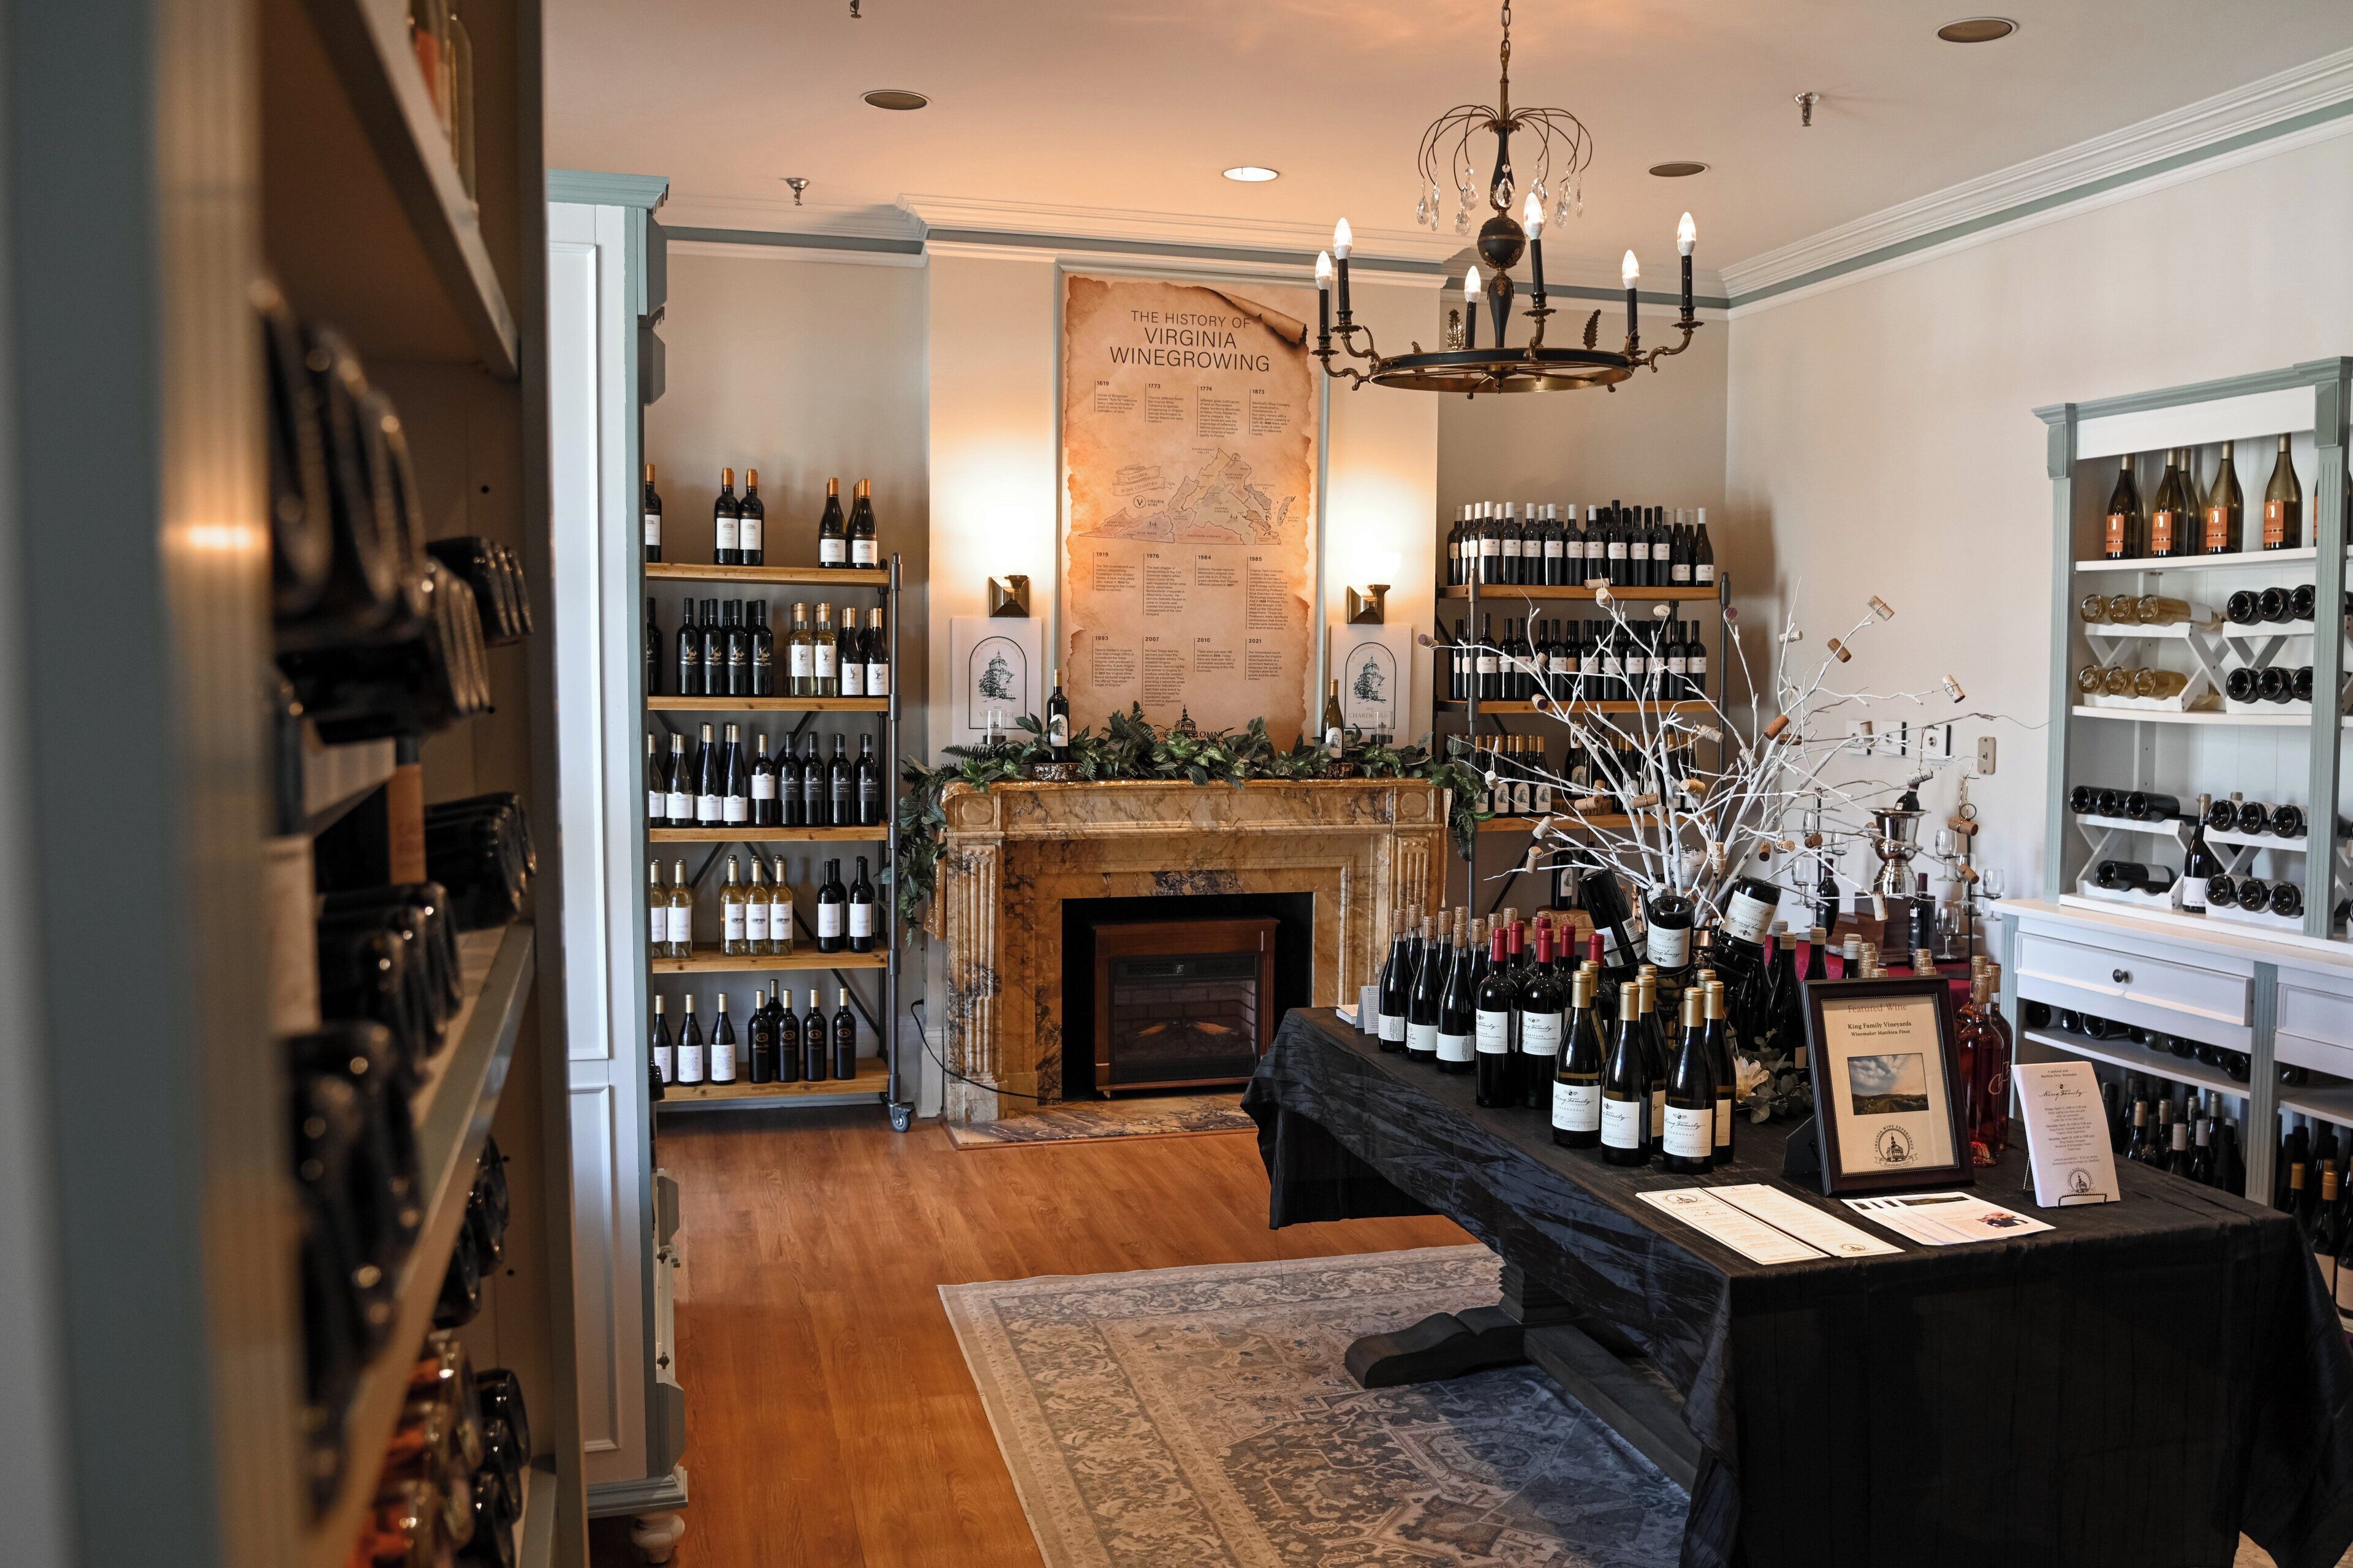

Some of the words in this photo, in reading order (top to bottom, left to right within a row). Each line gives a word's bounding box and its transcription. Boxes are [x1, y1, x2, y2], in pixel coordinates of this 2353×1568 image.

[1131, 310, 1159, 323] THE
[1166, 313, 1225, 327] HISTORY
[1232, 317, 1250, 329] OF
[1145, 327, 1236, 349] VIRGINIA
[1110, 347, 1269, 372] WINEGROWING
[1127, 472, 1148, 481] VIRGINIA
[1135, 482, 1157, 491] COUNTRY
[1848, 1004, 1882, 1013] Featured
[1886, 1002, 1907, 1011] Wine
[1479, 1021, 1500, 1030] Family
[1554, 1094, 1567, 1104] King
[1567, 1097, 1595, 1106] Family
[2038, 1091, 2059, 1101] King
[1605, 1111, 1631, 1121] Family
[1676, 1121, 1706, 1130] Family
[1896, 1125, 1913, 1149] EXPERIENCE
